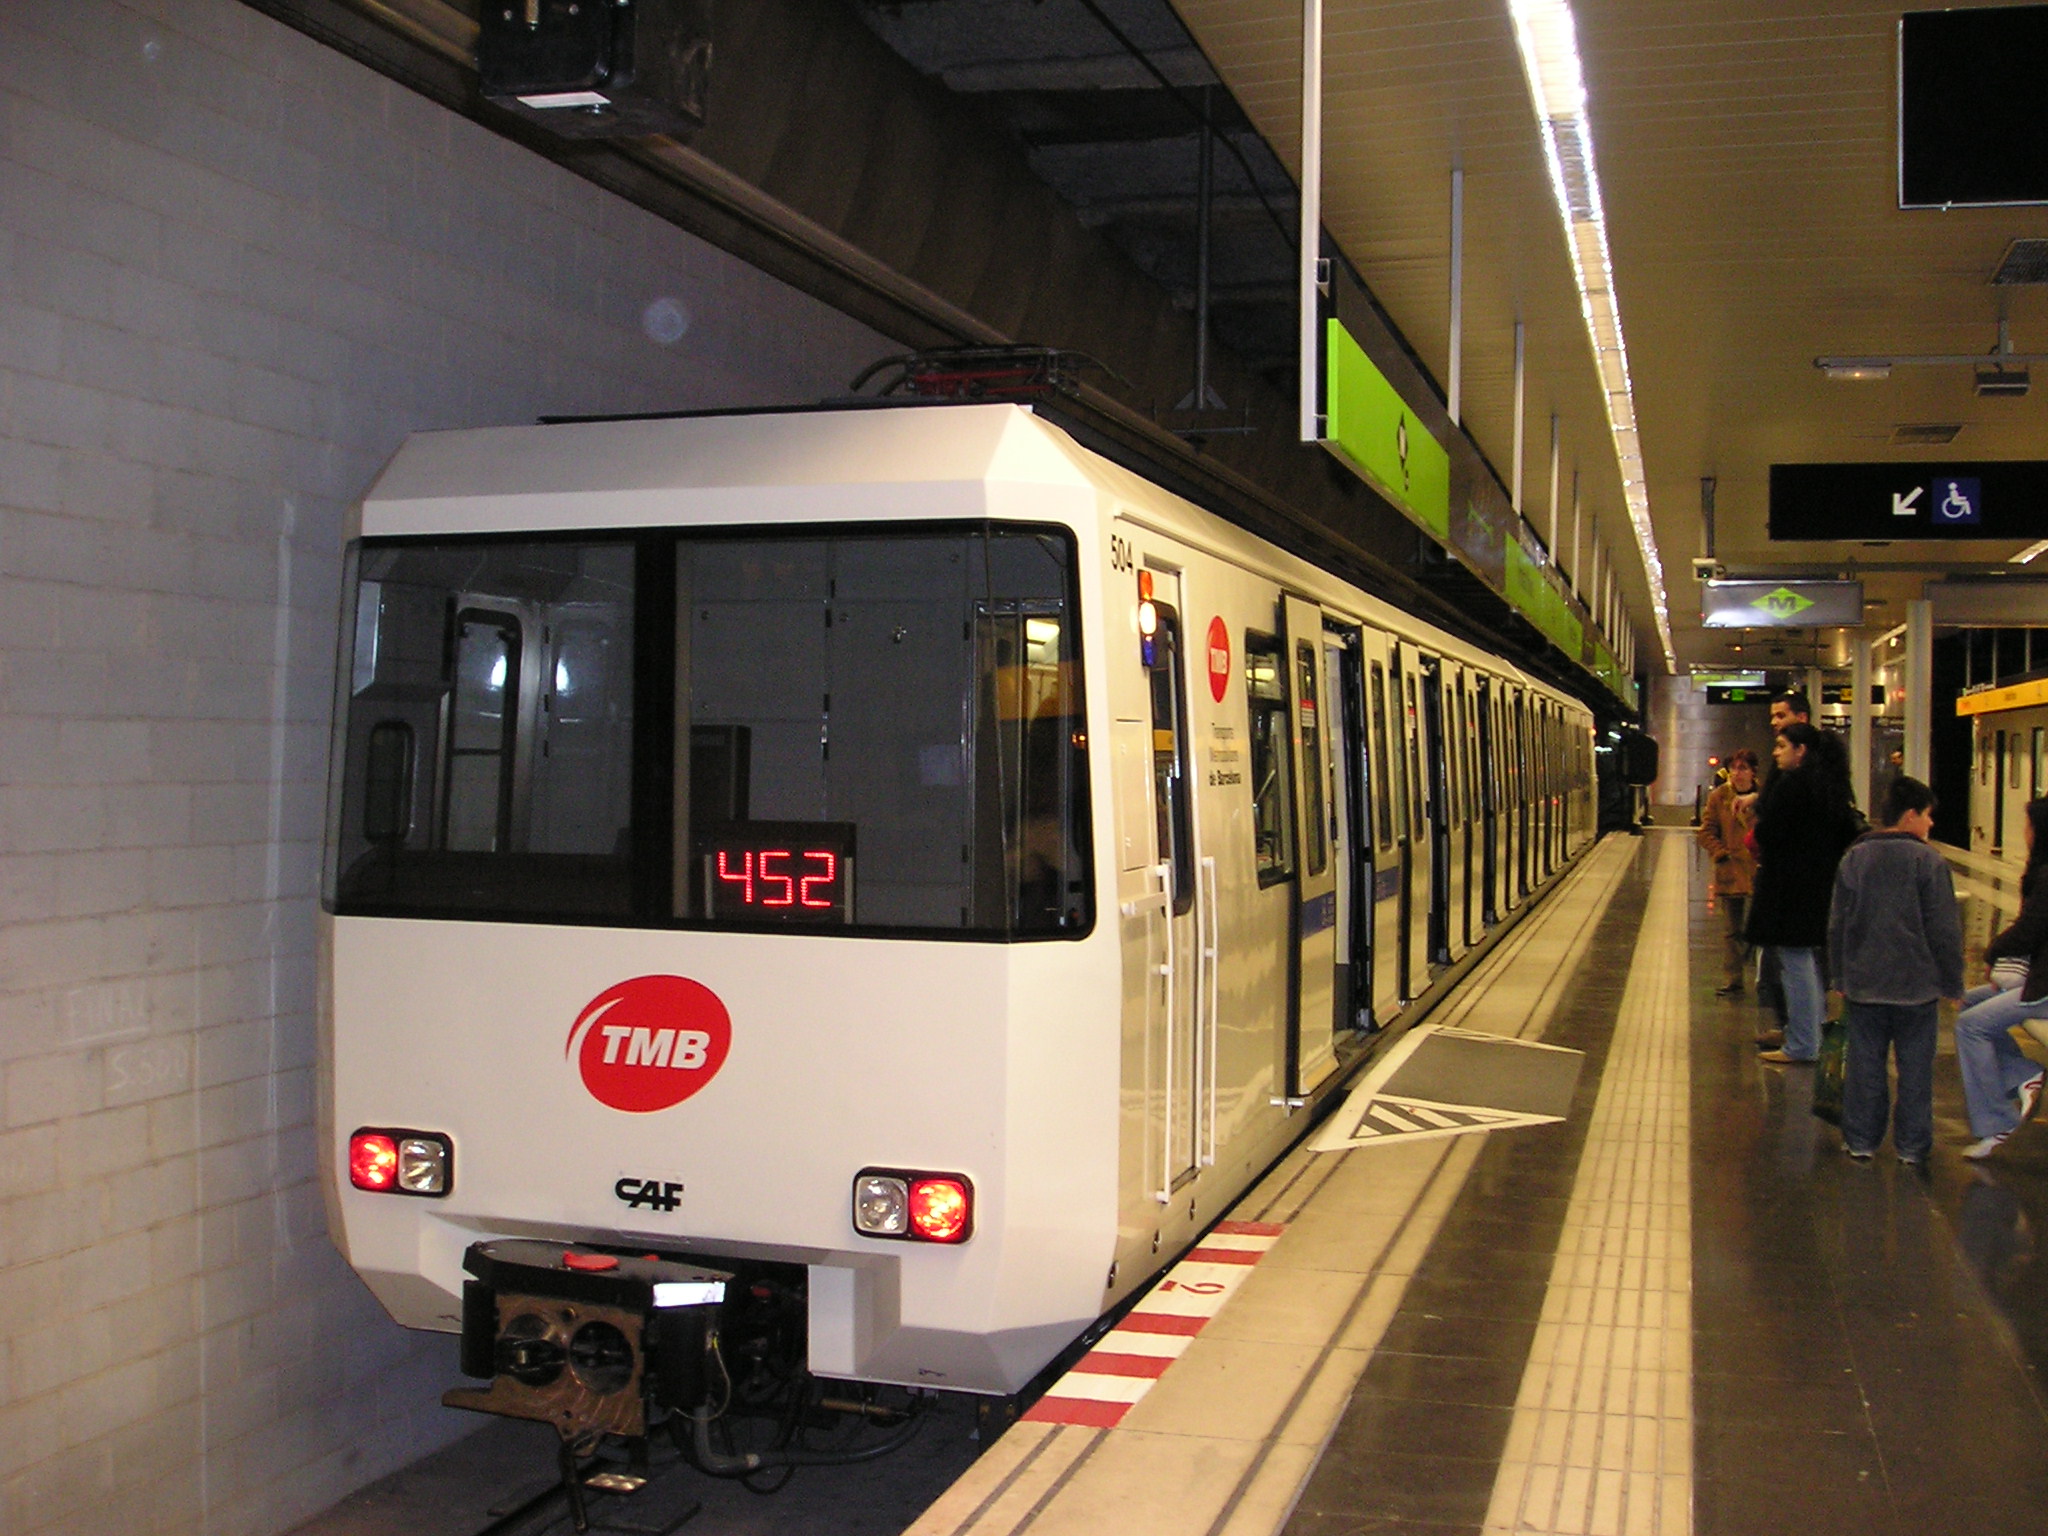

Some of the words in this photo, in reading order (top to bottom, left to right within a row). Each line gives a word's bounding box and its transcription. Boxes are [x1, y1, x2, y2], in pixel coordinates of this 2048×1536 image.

[1111, 534, 1133, 575] 504
[1767, 596, 1797, 611] M
[717, 850, 835, 907] 452
[600, 1024, 711, 1070] TMB
[615, 1178, 685, 1212] CAF
